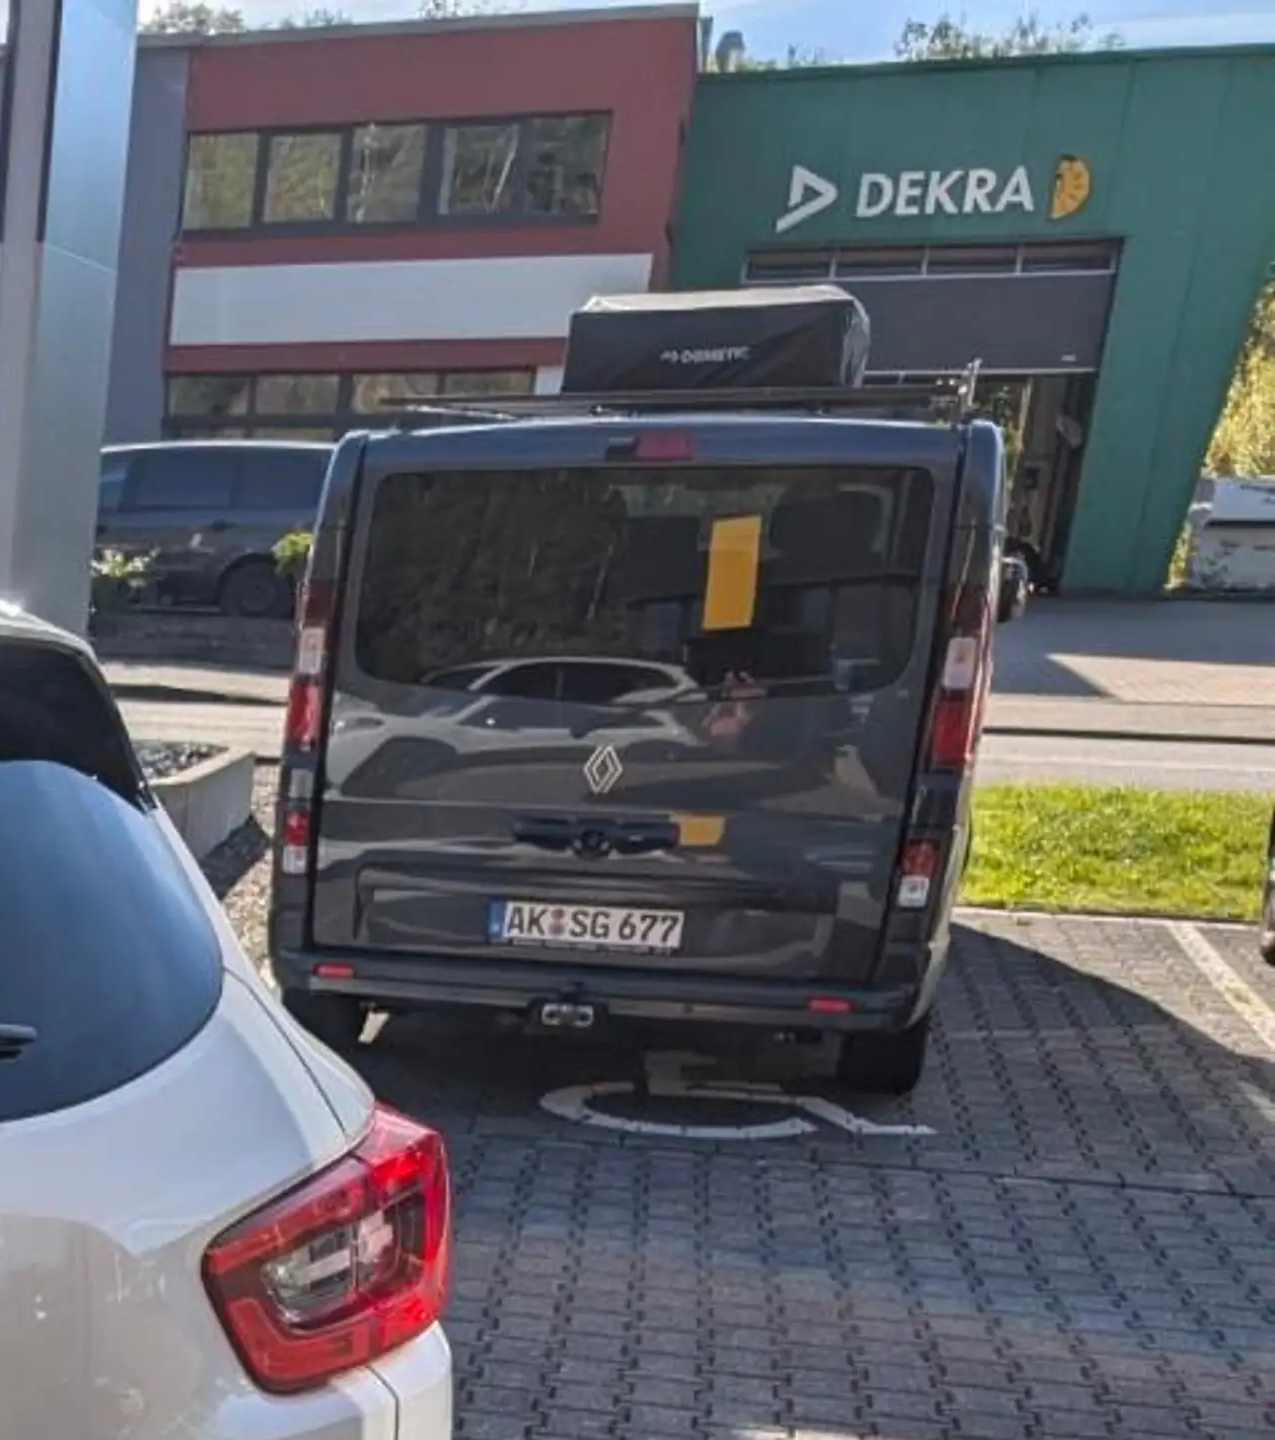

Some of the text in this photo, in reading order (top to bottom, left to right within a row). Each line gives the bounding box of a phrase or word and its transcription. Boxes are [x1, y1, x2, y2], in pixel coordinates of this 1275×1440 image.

[855, 165, 1035, 218] DEKRA
[506, 905, 681, 943] AK SG 677
